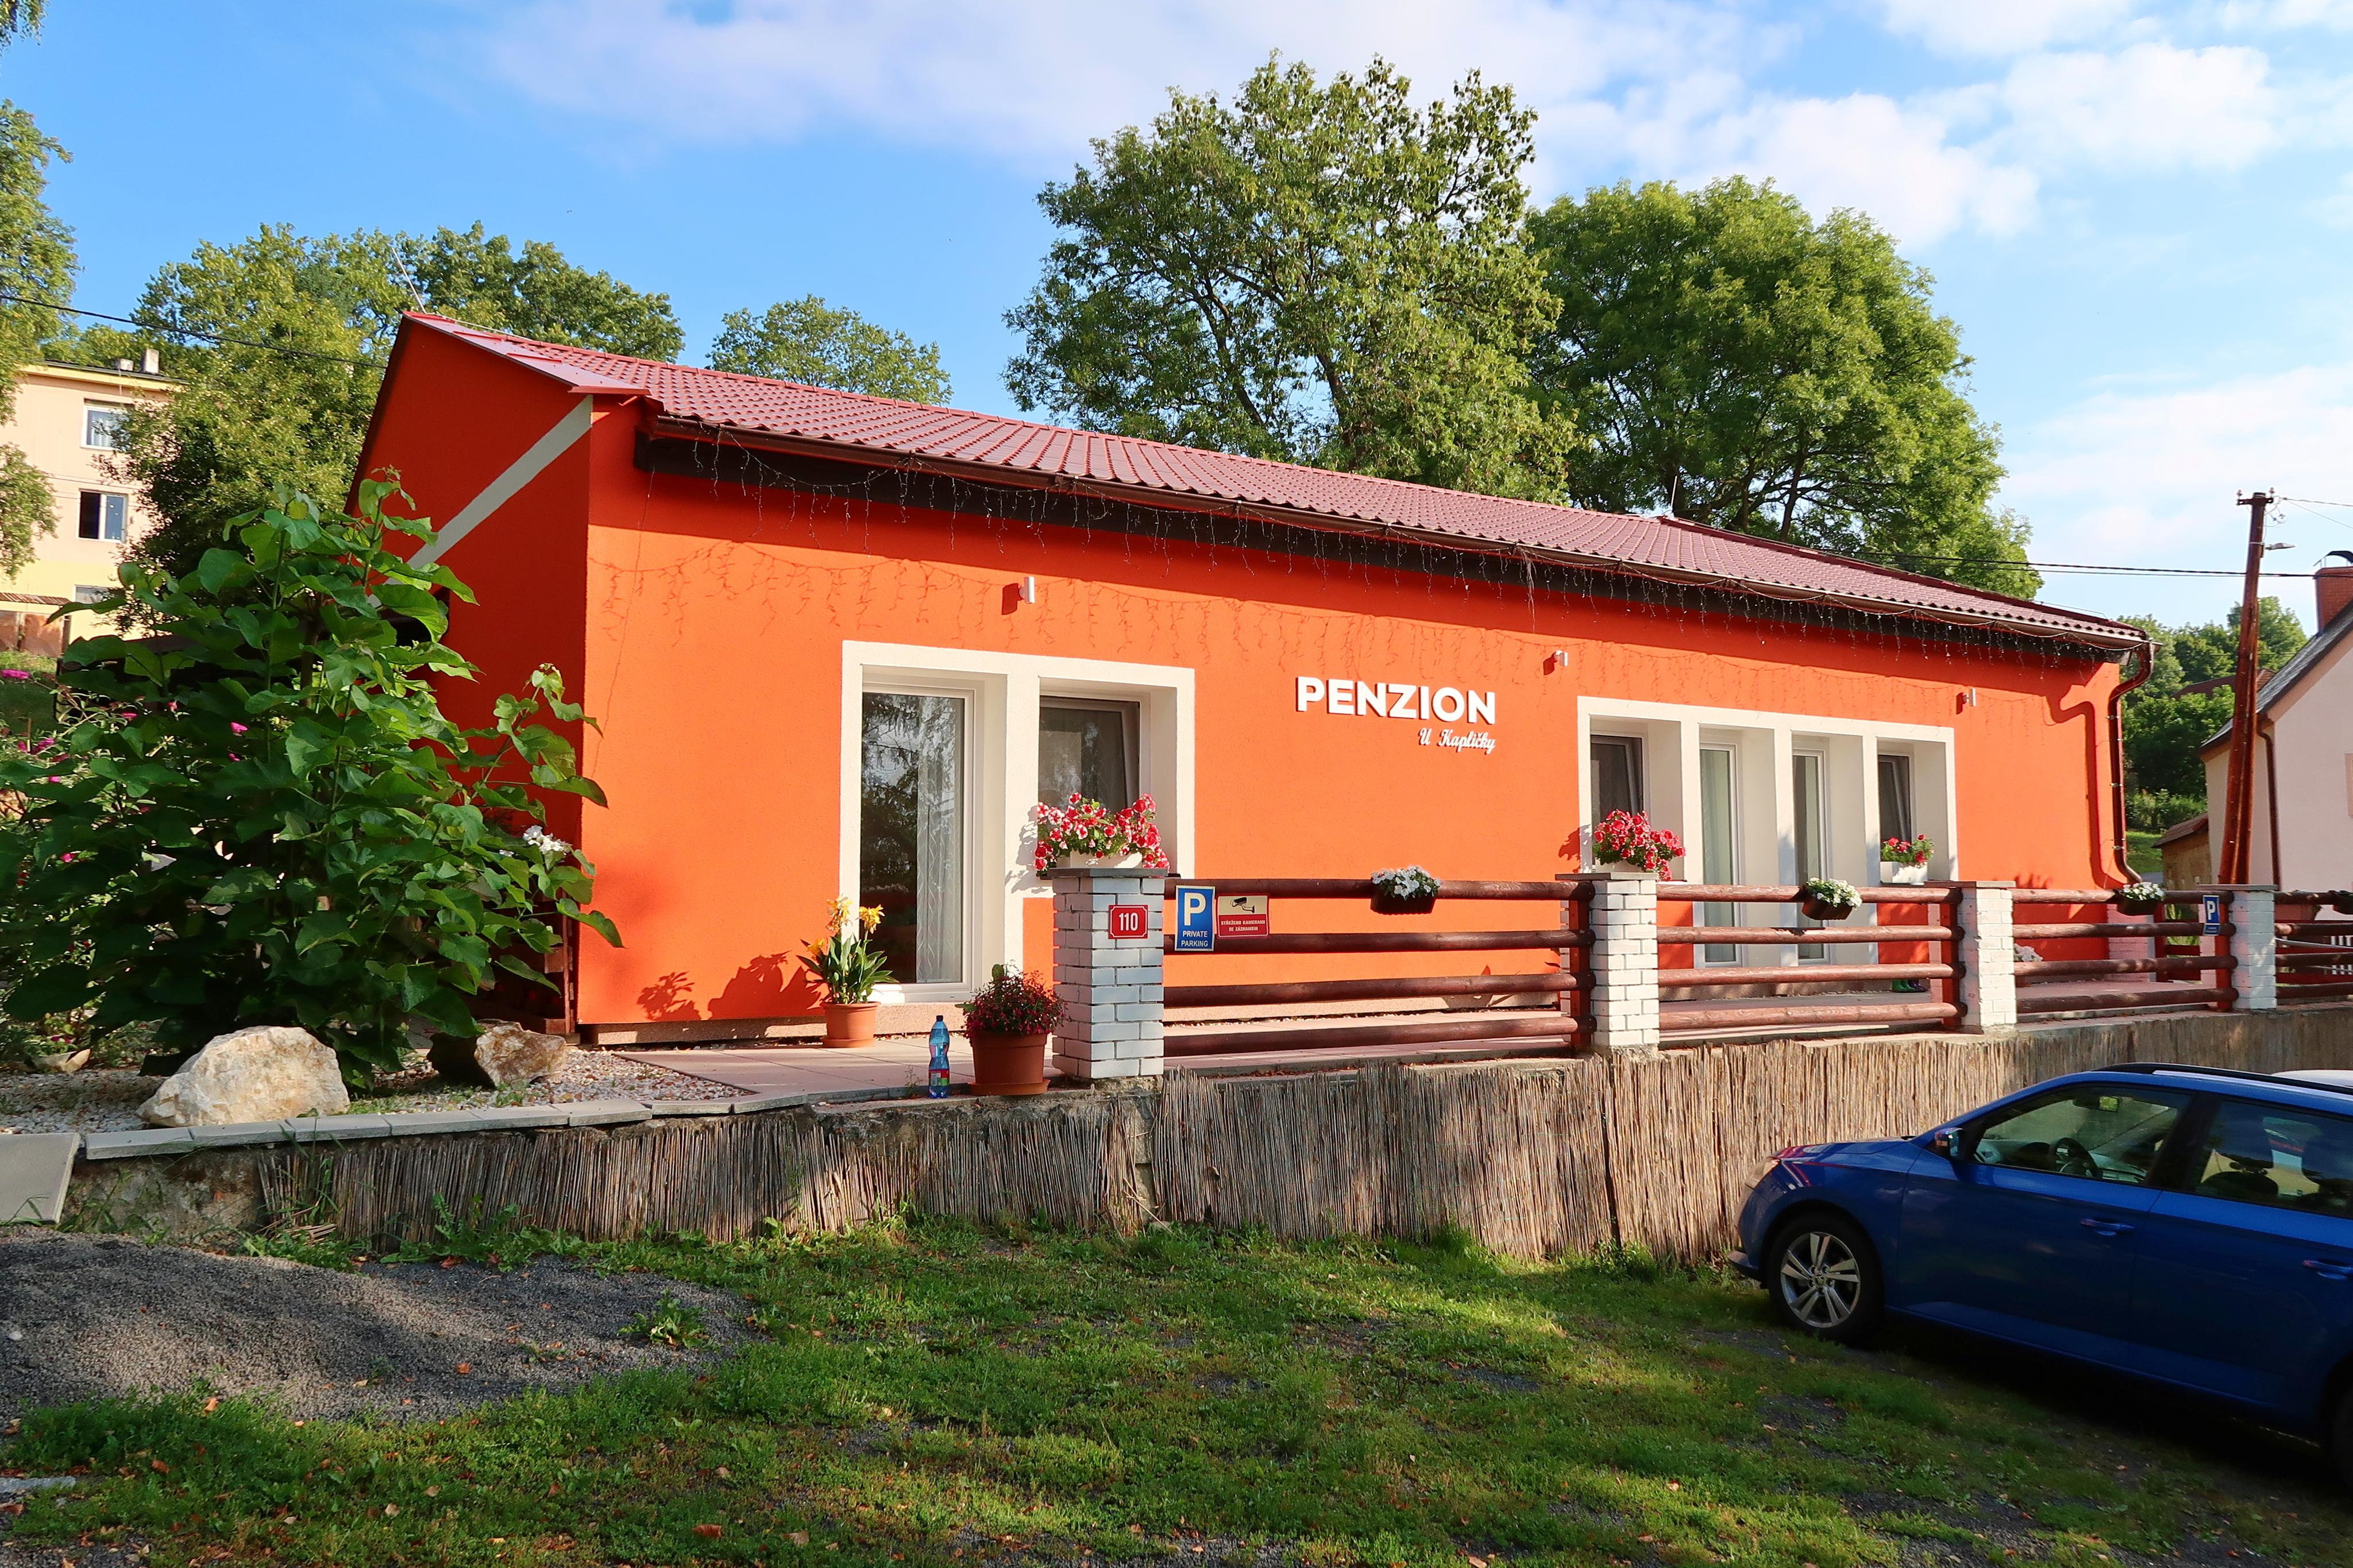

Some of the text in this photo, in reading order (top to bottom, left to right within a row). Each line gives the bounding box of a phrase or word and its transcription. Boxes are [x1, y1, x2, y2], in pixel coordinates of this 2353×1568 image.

[1296, 676, 1495, 725] PENZION
[1419, 727, 1496, 755] U Kapličky
[1118, 912, 1139, 931] 110
[1184, 892, 1206, 926] P
[2207, 901, 2216, 920] P
